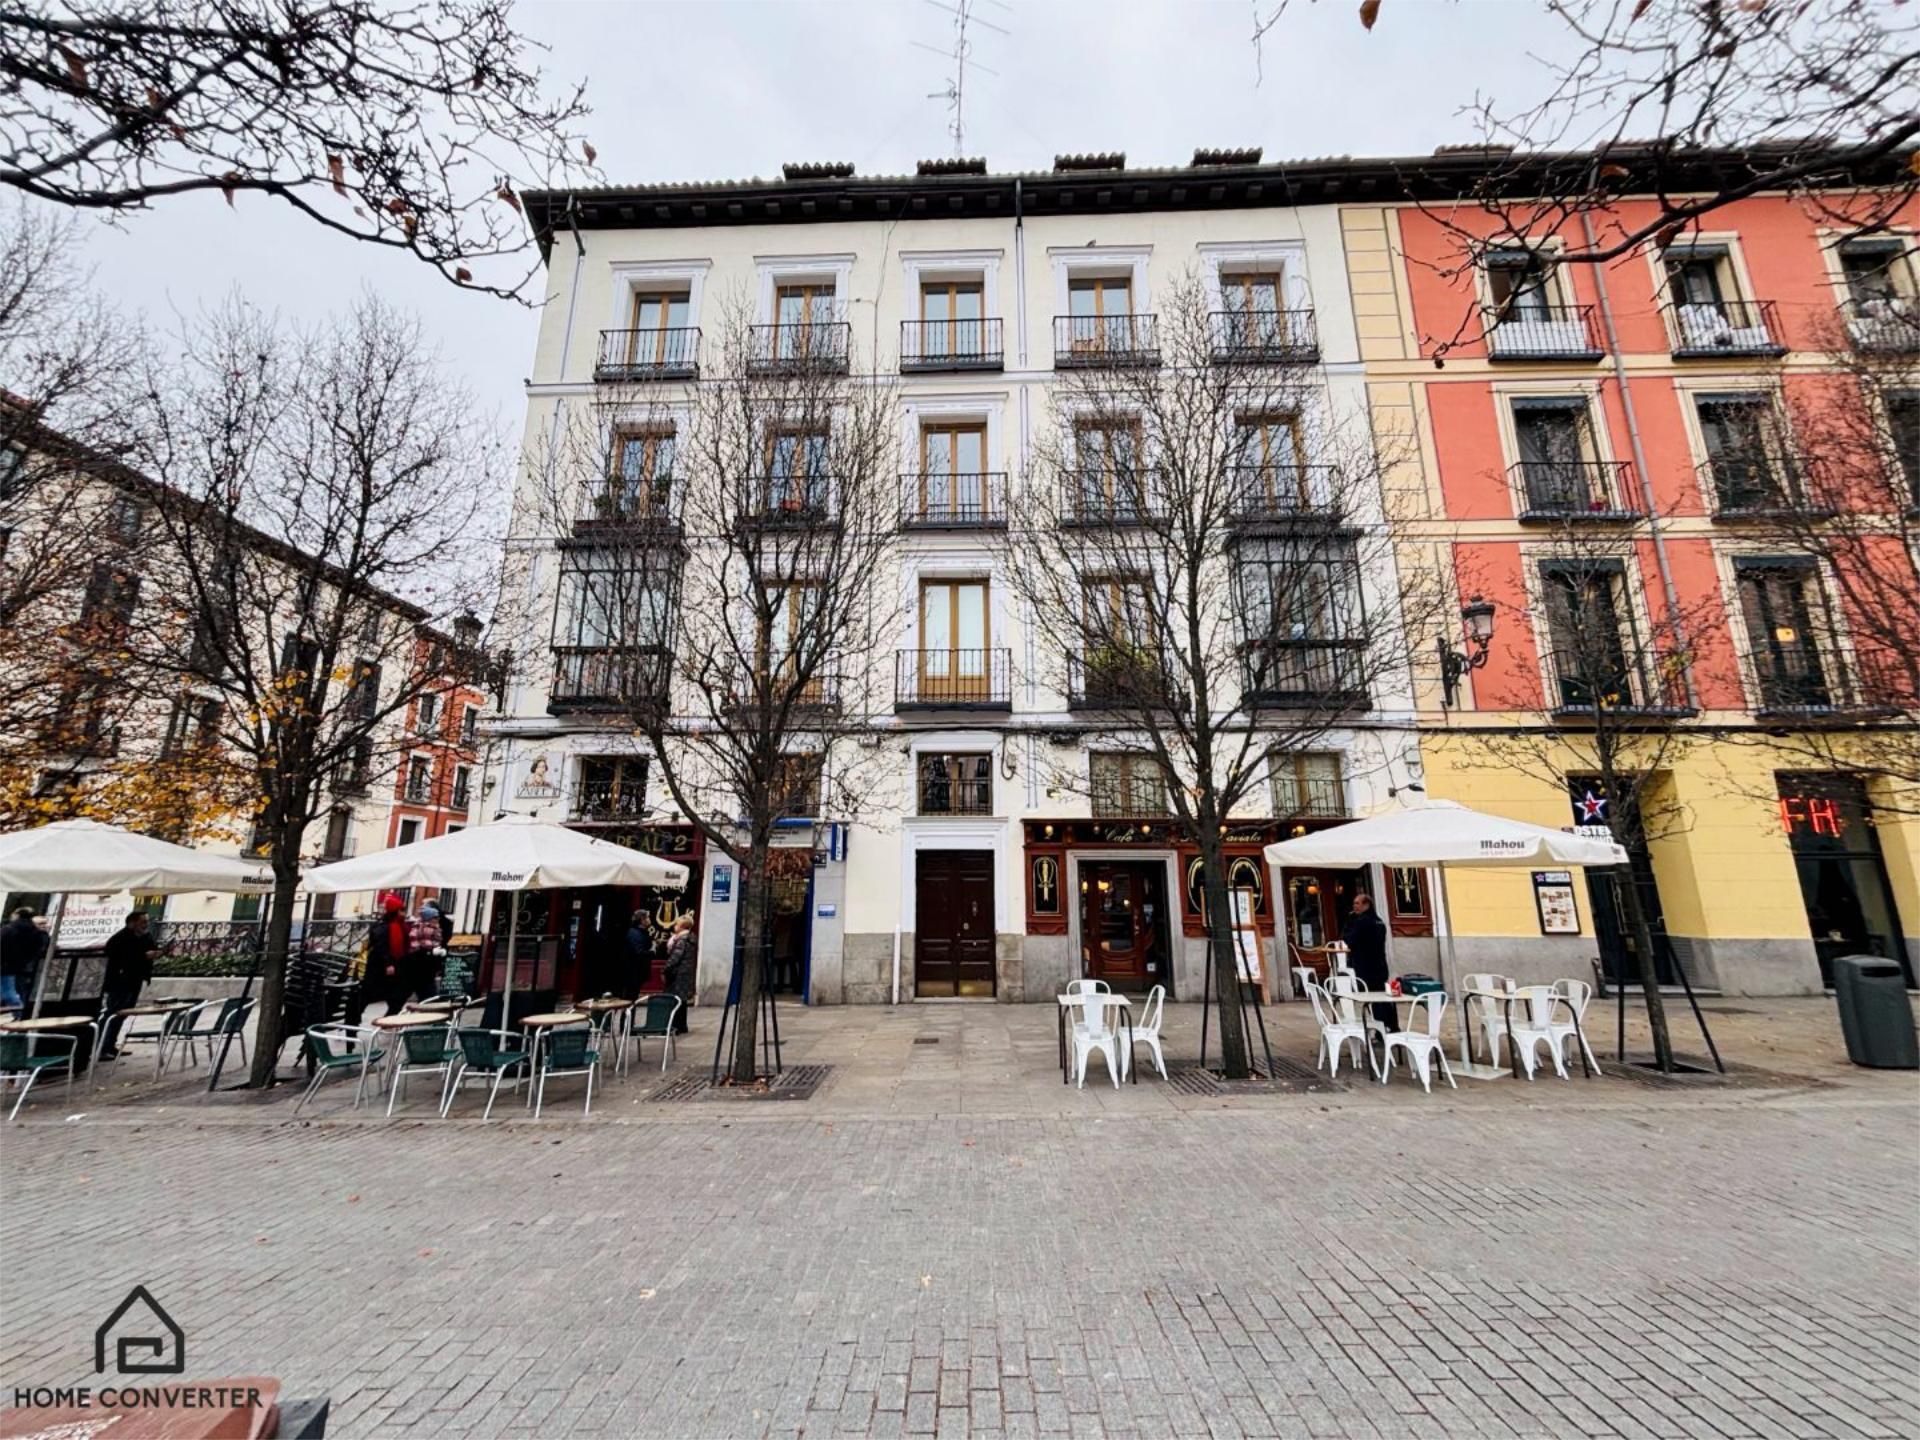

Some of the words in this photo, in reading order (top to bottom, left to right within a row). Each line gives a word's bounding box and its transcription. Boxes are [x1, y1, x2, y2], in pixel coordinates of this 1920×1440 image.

[673, 834, 688, 852] 2
[1480, 839, 1525, 849] Mahou
[491, 871, 524, 882] Mahou
[62, 918, 113, 928] CORDERO
